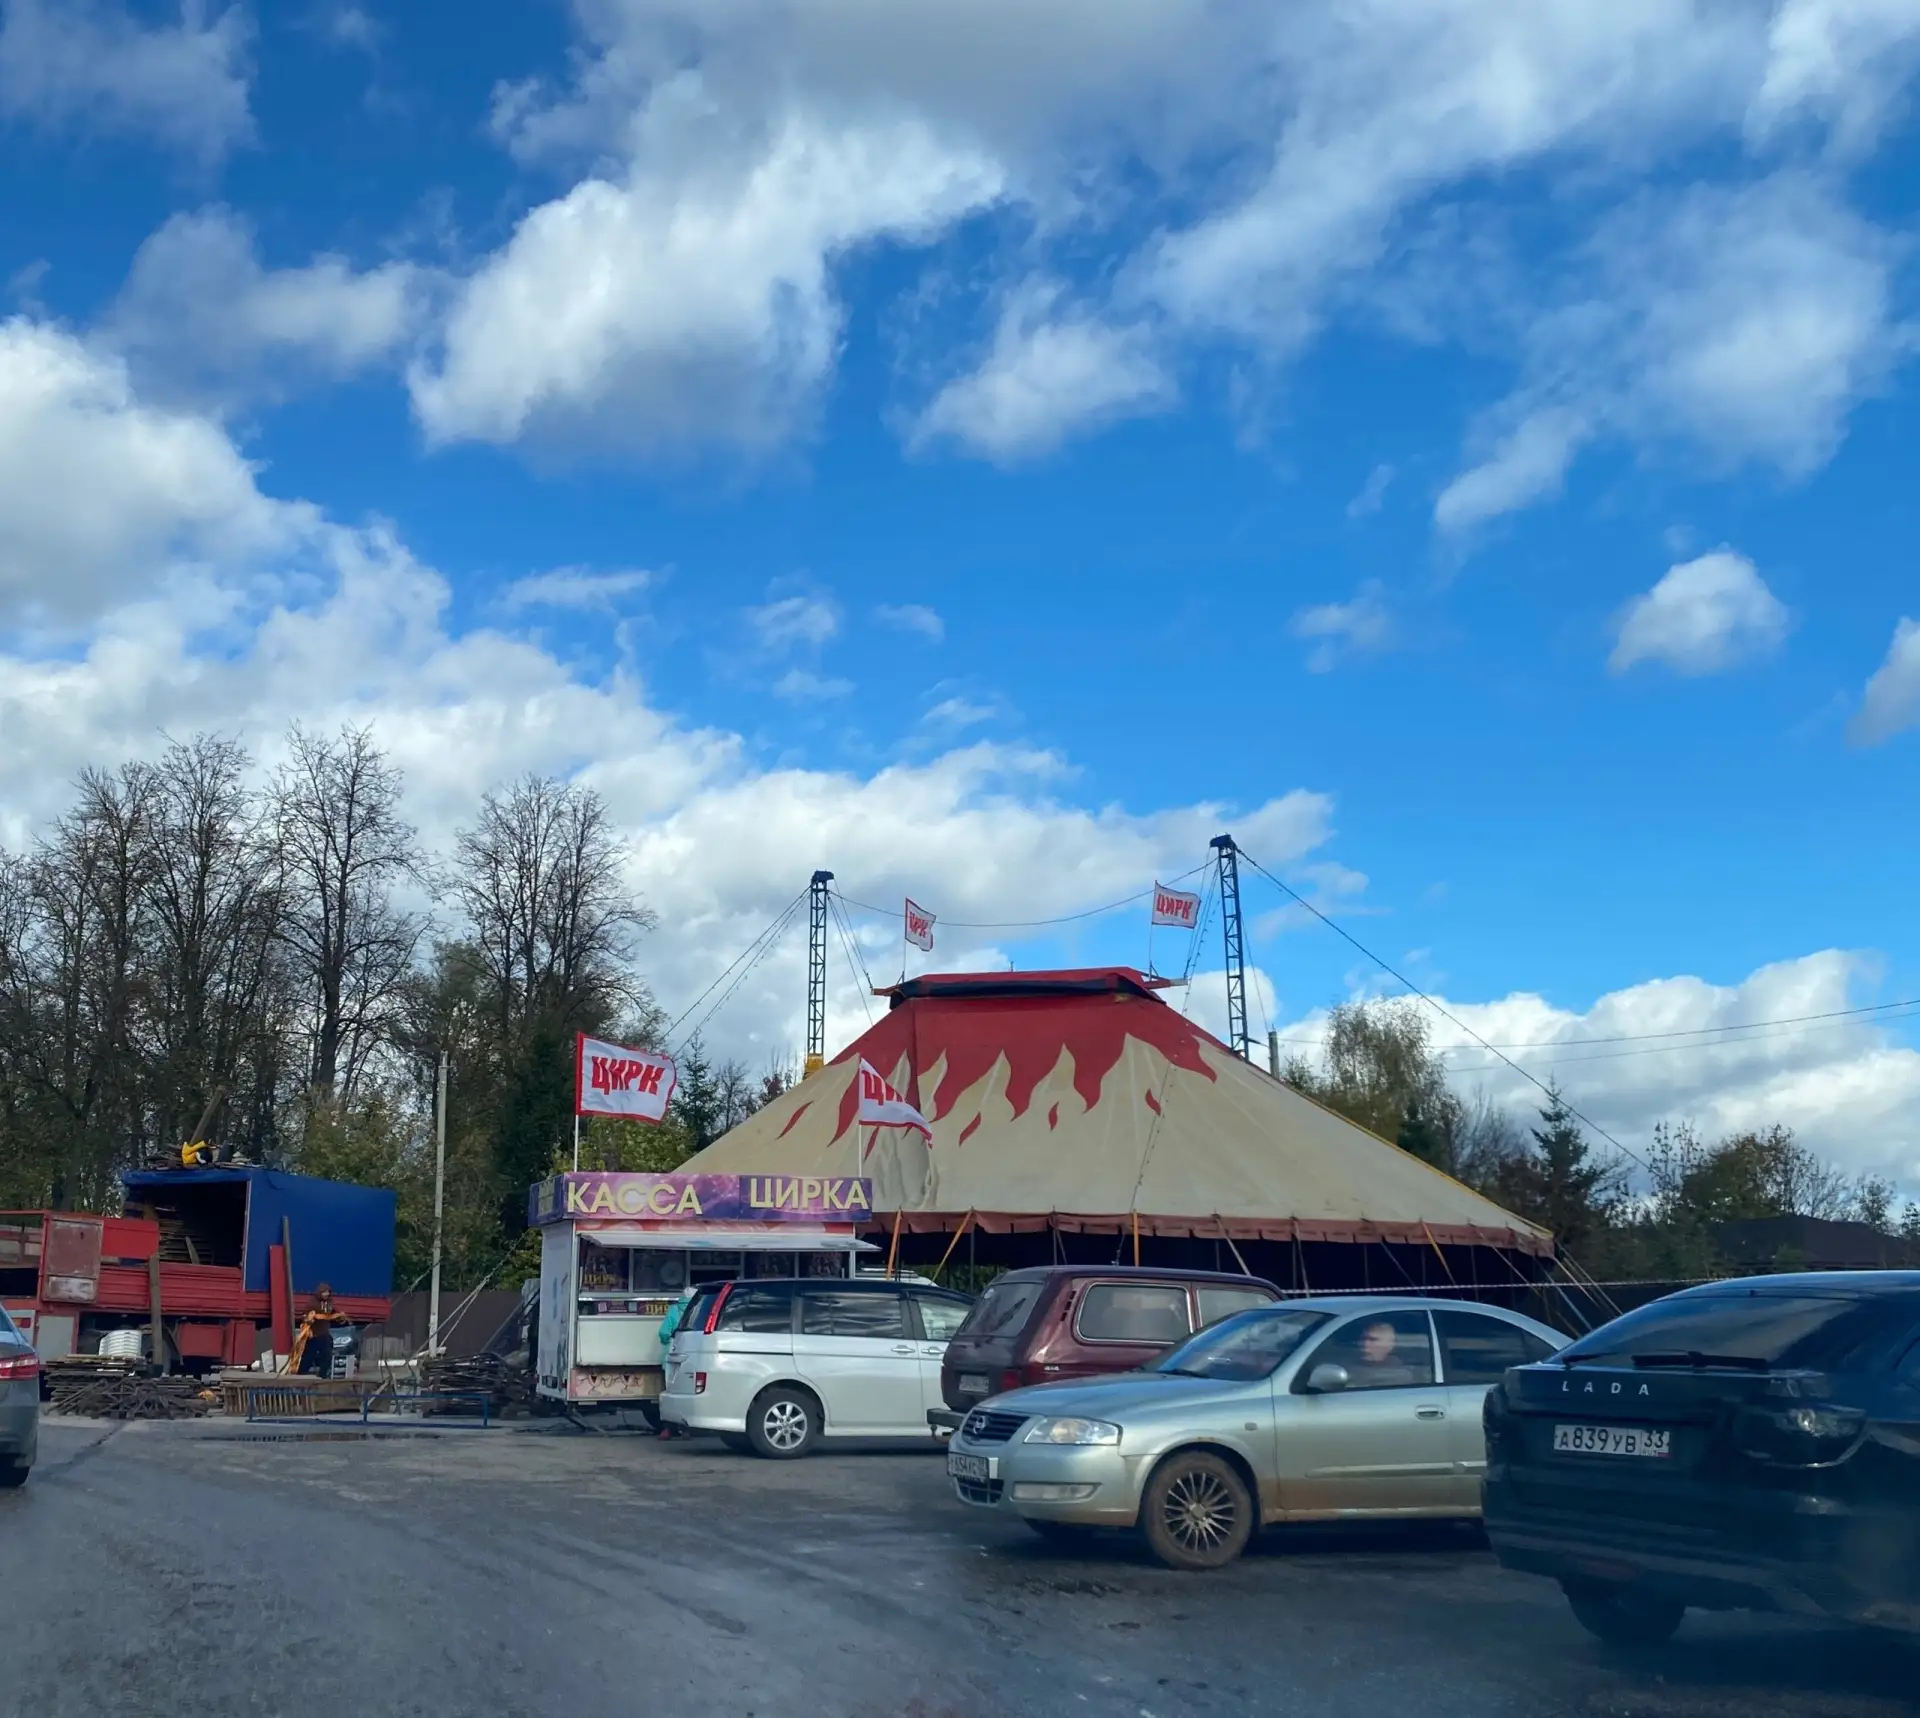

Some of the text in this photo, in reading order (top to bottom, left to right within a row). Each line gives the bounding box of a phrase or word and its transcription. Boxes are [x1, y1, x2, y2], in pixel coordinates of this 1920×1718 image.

[1156, 893, 1193, 919] ЦИРК
[591, 1056, 665, 1096] ЦИРК
[567, 1182, 703, 1215] КАССА
[750, 1178, 870, 1210] ЦИРКА
[1562, 1381, 1649, 1395] LADA
